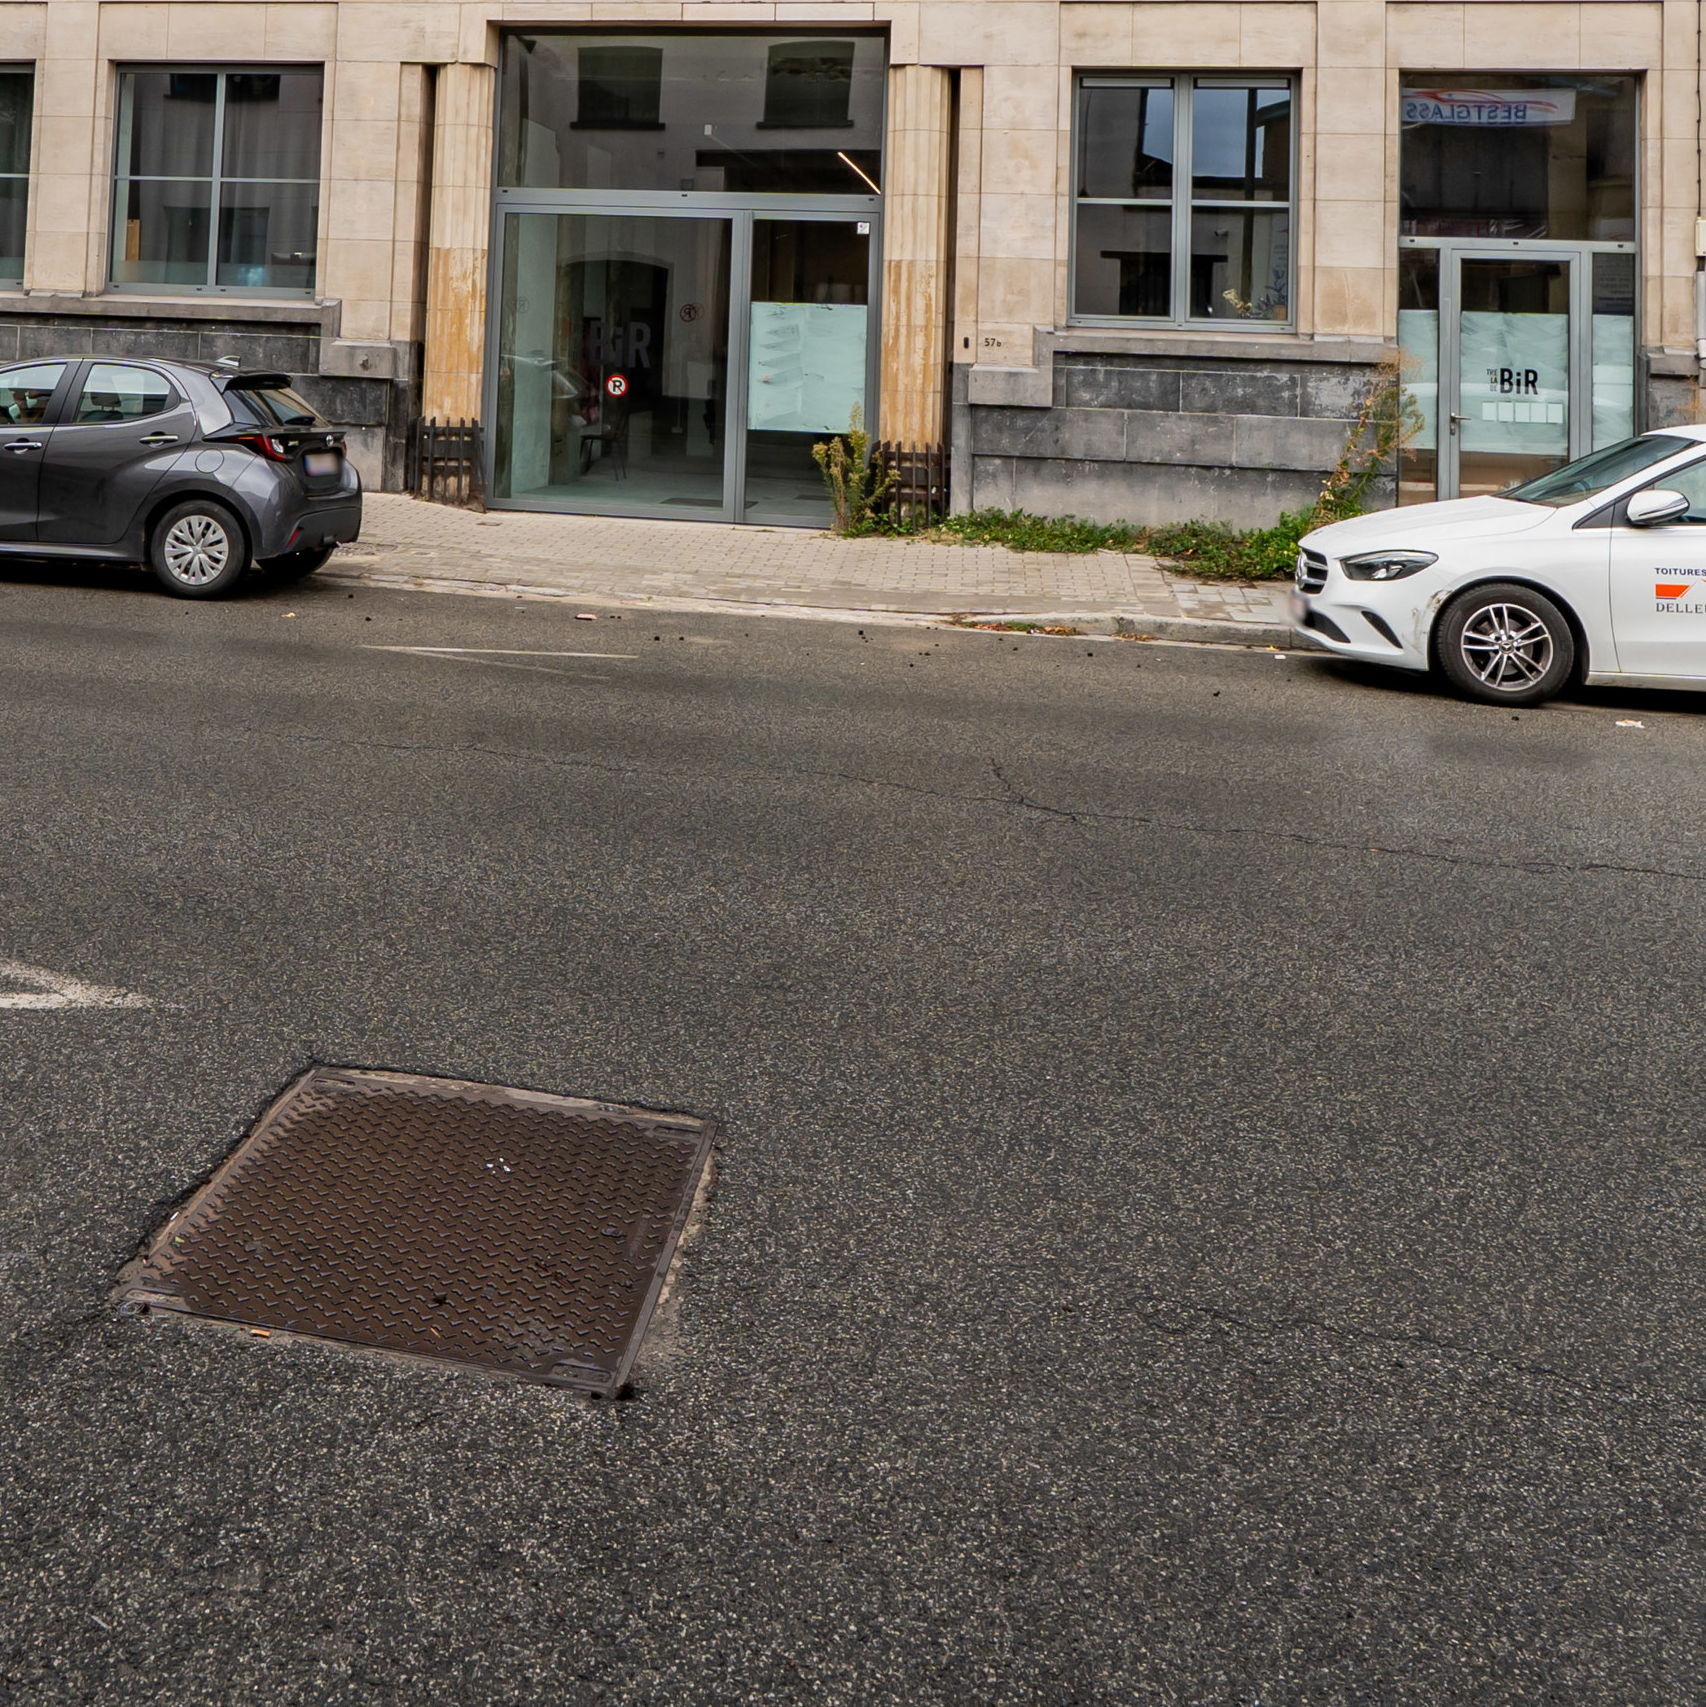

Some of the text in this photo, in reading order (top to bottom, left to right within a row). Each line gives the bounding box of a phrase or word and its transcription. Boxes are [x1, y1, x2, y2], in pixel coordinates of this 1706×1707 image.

[590, 321, 652, 368] BiR
[984, 337, 1002, 347] 57b
[1500, 368, 1539, 395] BiR
